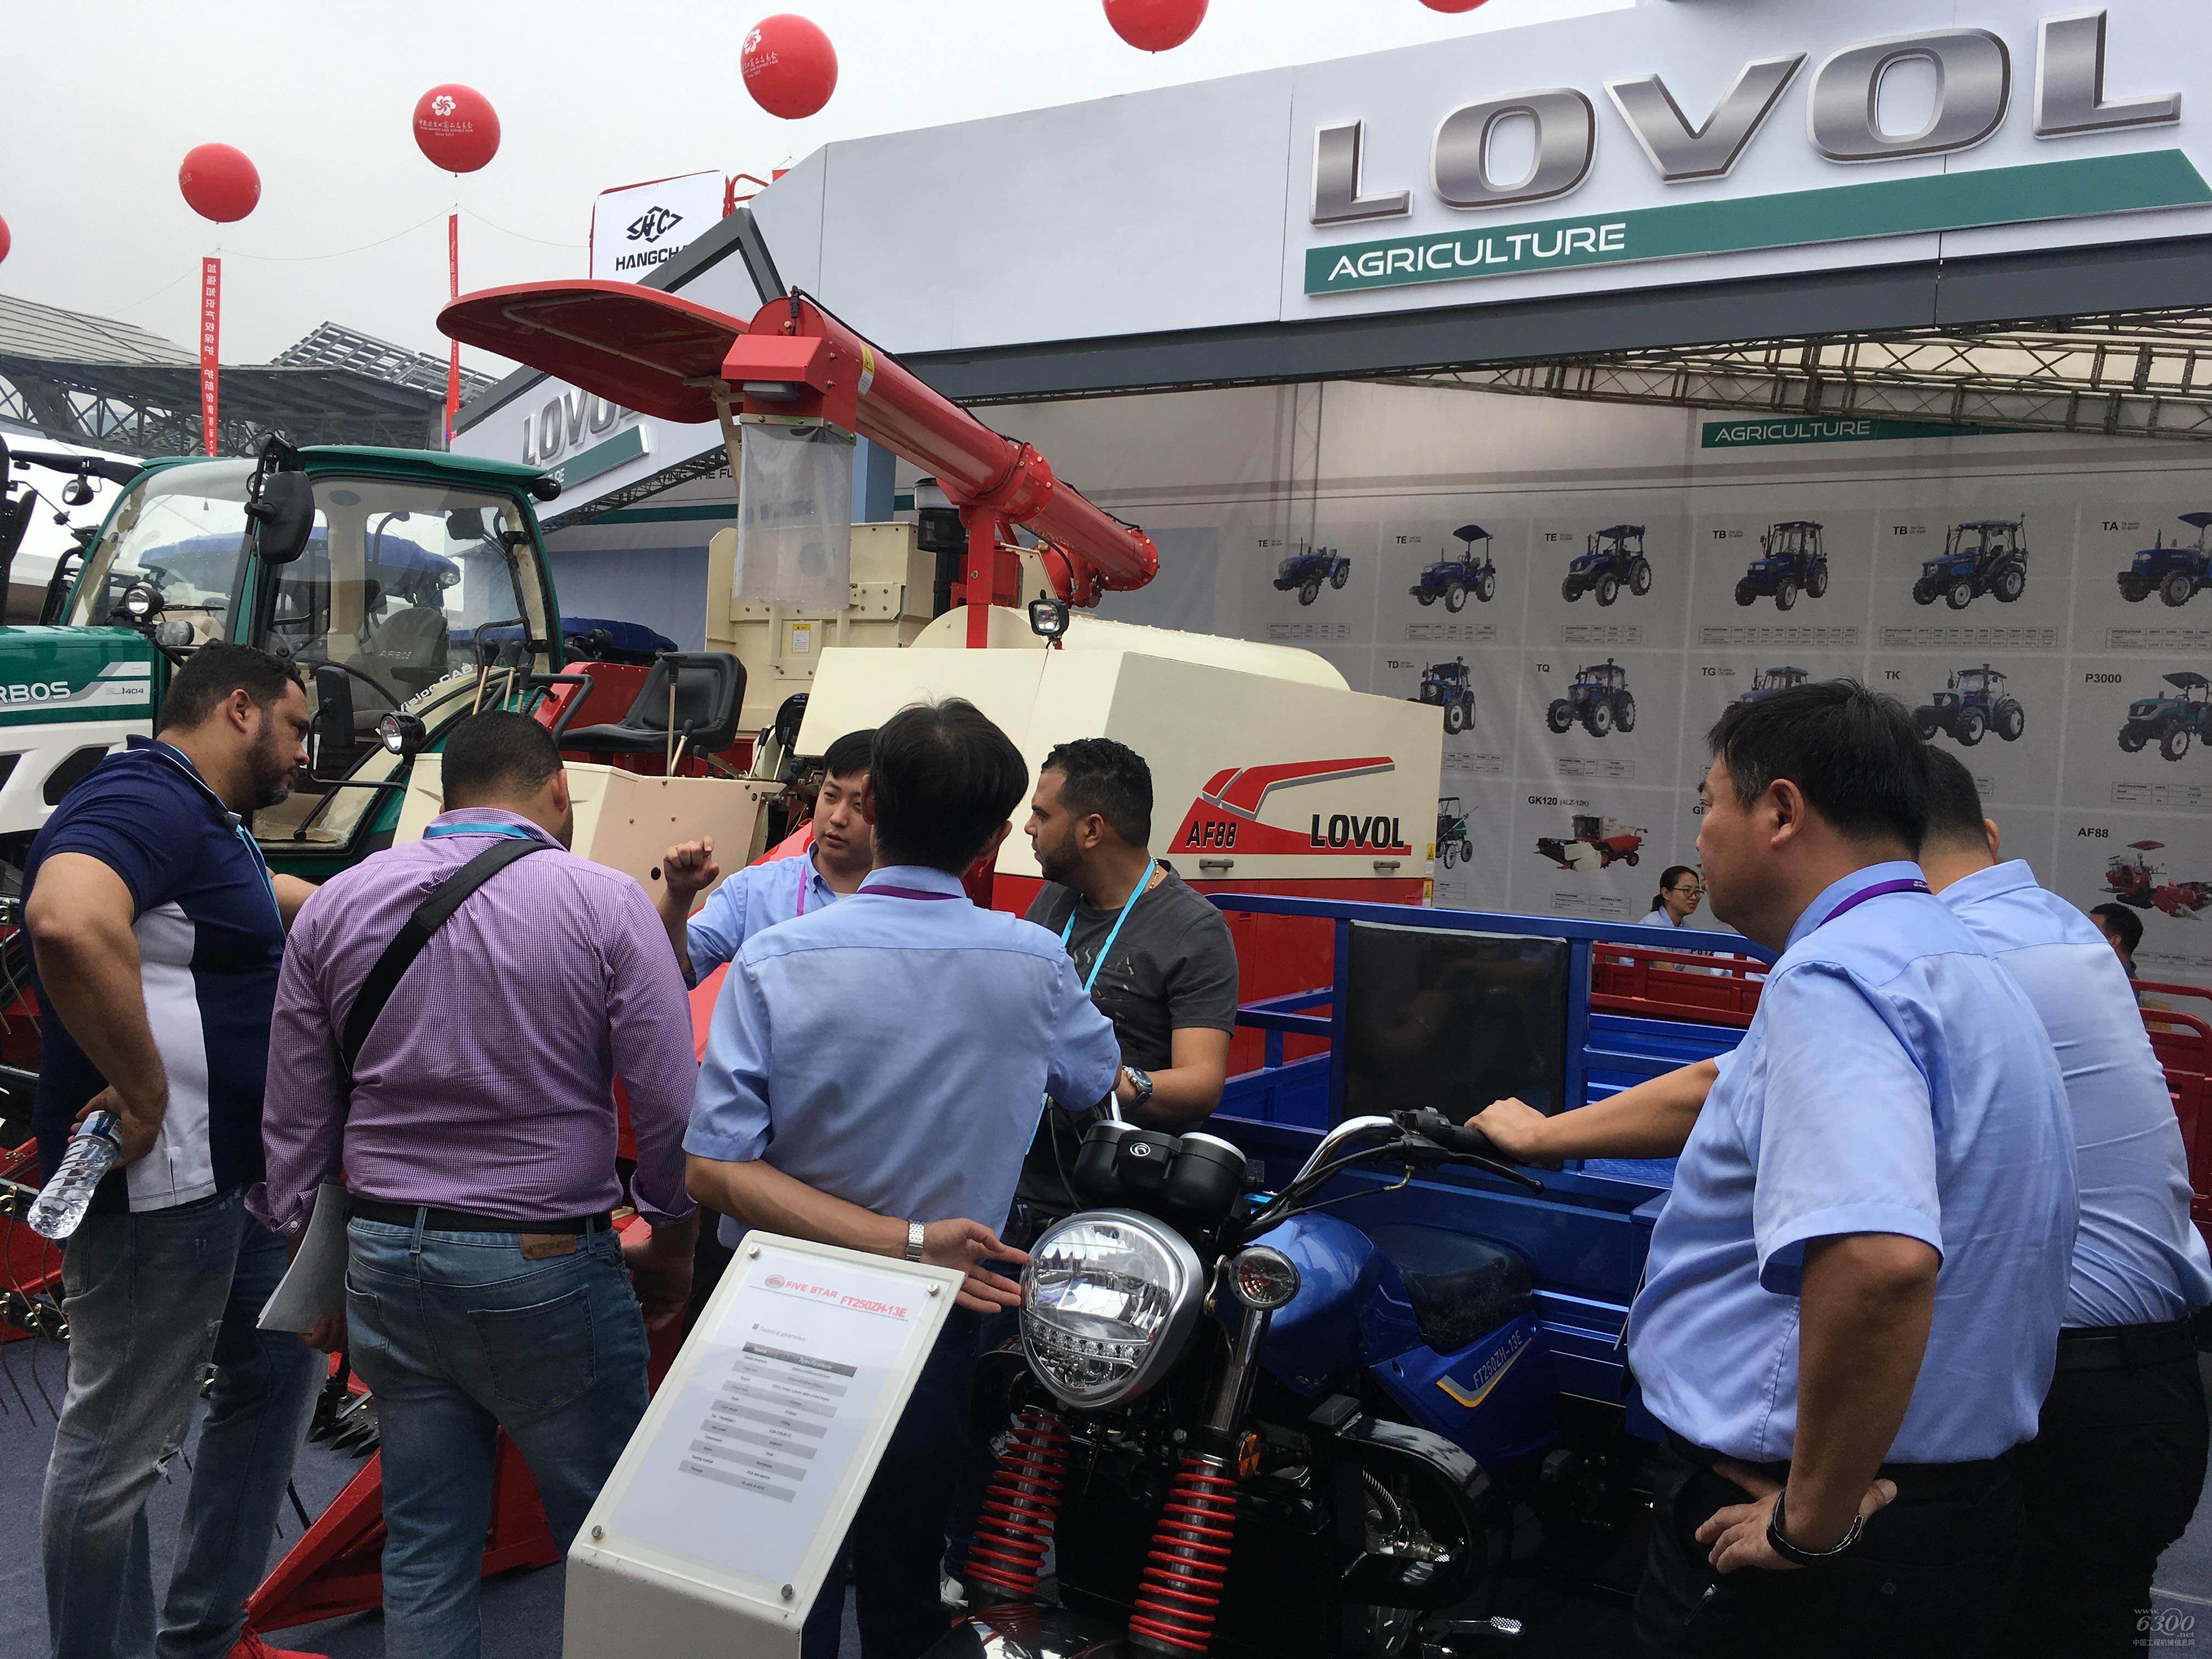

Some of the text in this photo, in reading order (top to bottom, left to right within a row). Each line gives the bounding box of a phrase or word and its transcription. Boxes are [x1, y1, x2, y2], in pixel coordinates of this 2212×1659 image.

[1308, 8, 2182, 227] LOVOL
[1327, 222, 1627, 281] AGRICULTURE
[616, 246, 689, 271] HANGCH
[1714, 420, 1871, 442] AGRICULTURE
[1893, 526, 1908, 535] TB
[2101, 521, 2119, 531] TA
[1545, 533, 1557, 541] TE
[1713, 530, 1726, 539] TB
[1536, 664, 1550, 673] TQ
[1701, 667, 1716, 676] TG
[1884, 670, 1900, 680] TK
[2085, 673, 2122, 684] P3000
[1528, 795, 1558, 805] GK120
[1185, 821, 1237, 848] AF88
[1310, 814, 1404, 849] LOVOL
[2077, 827, 2109, 839] AF88
[785, 1281, 907, 1317] FIVE STAR FT250ZH-13E
[799, 1357, 832, 1370] Specifications
[1473, 1329, 1523, 1390] FT250ZH-13E
